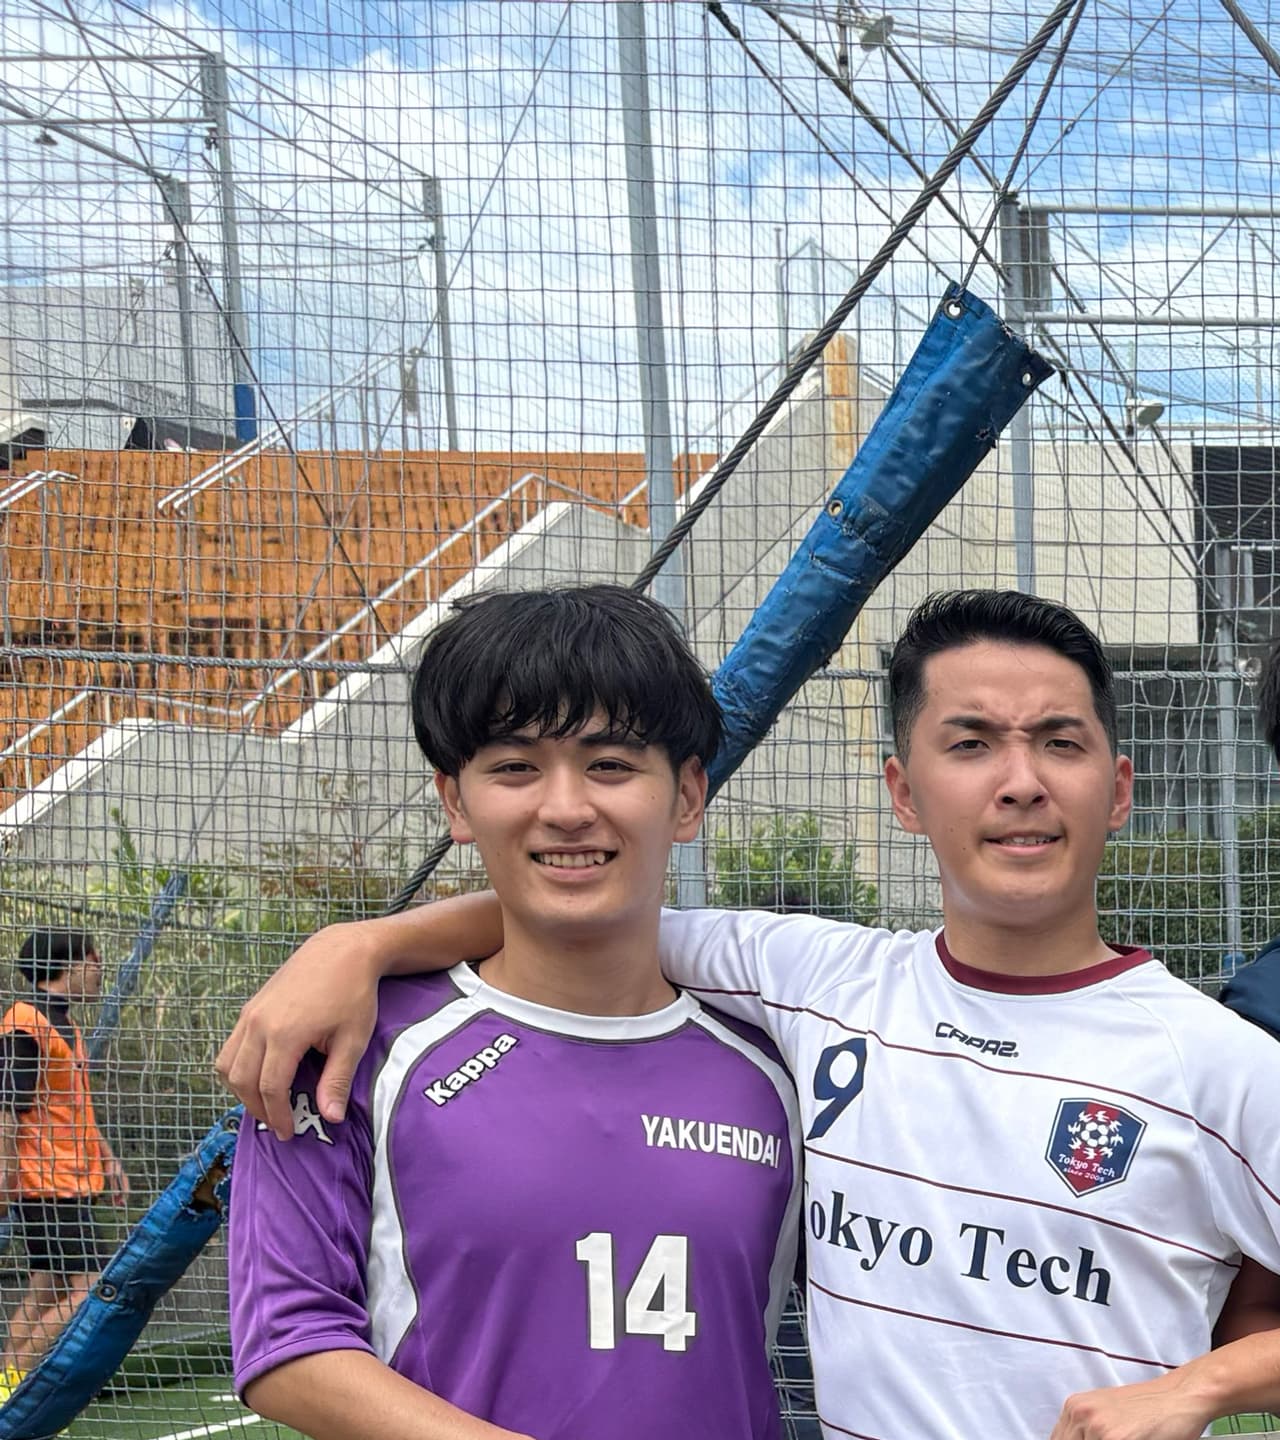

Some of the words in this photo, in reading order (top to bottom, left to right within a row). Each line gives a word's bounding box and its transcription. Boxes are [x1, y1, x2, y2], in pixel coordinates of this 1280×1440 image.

[424, 1032, 519, 1106] Kappa
[806, 1037, 867, 1140] 9
[641, 1114, 782, 1168] YAKUENDAI
[1058, 1153, 1089, 1169] Tokyo
[1092, 1163, 1115, 1178] Tech
[804, 1182, 933, 1271] okyo
[959, 1223, 1113, 1306] Tech
[576, 1232, 697, 1352] 14
